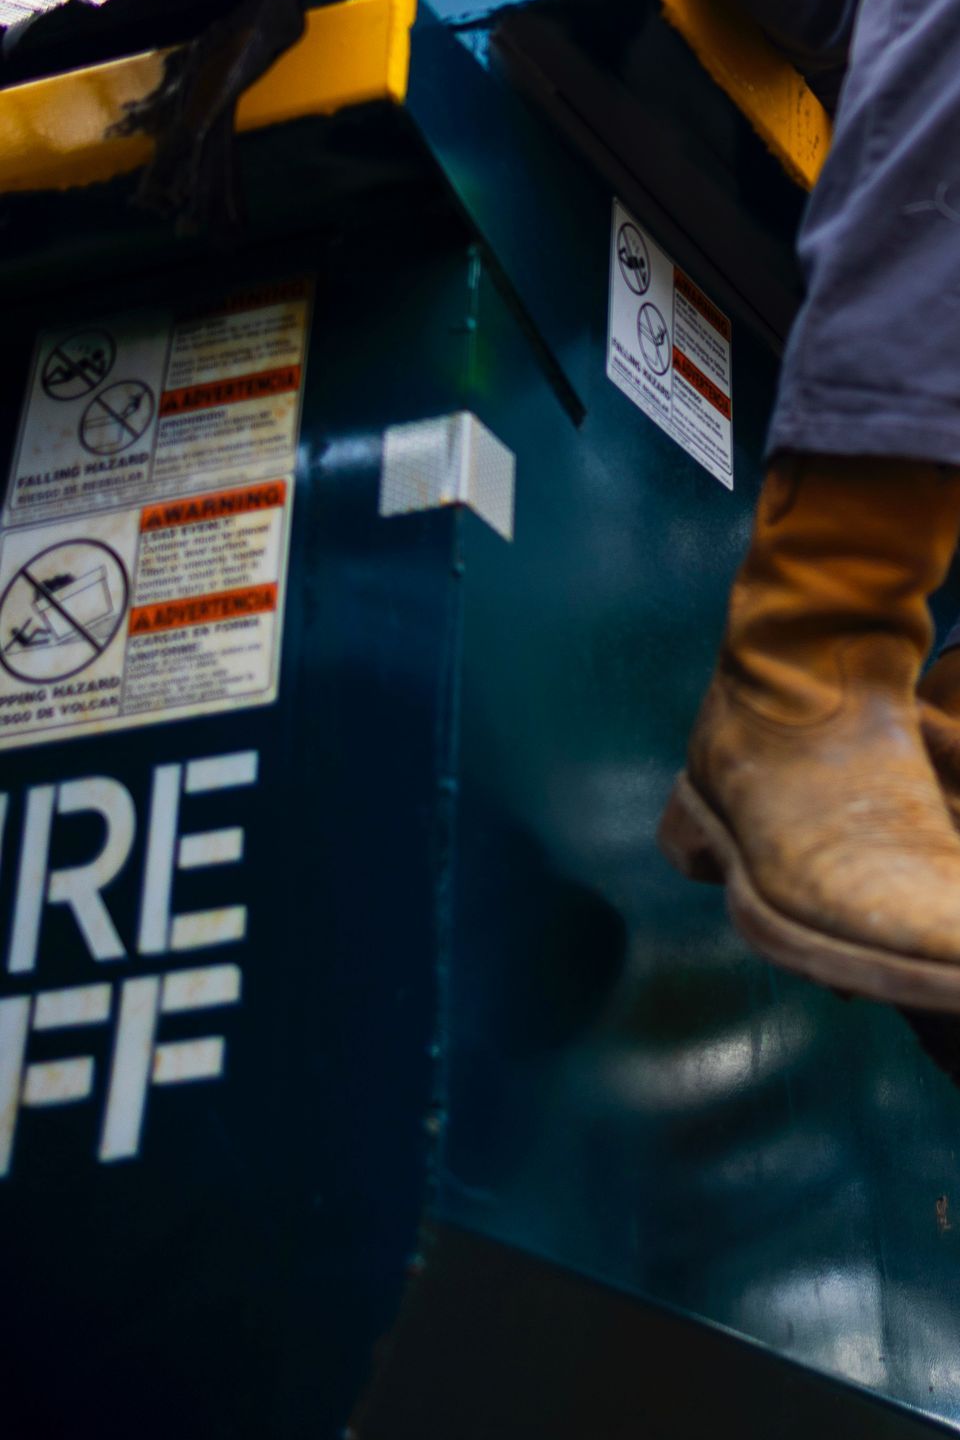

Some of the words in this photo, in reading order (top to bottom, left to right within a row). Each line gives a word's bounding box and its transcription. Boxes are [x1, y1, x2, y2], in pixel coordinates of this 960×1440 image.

[18, 465, 80, 488] FALLING
[85, 453, 149, 474] HAZARD
[165, 486, 280, 522] WARNING
[154, 590, 273, 626] ADVERTENCIA
[53, 676, 120, 698] HAZARD
[0, 750, 259, 974] RE
